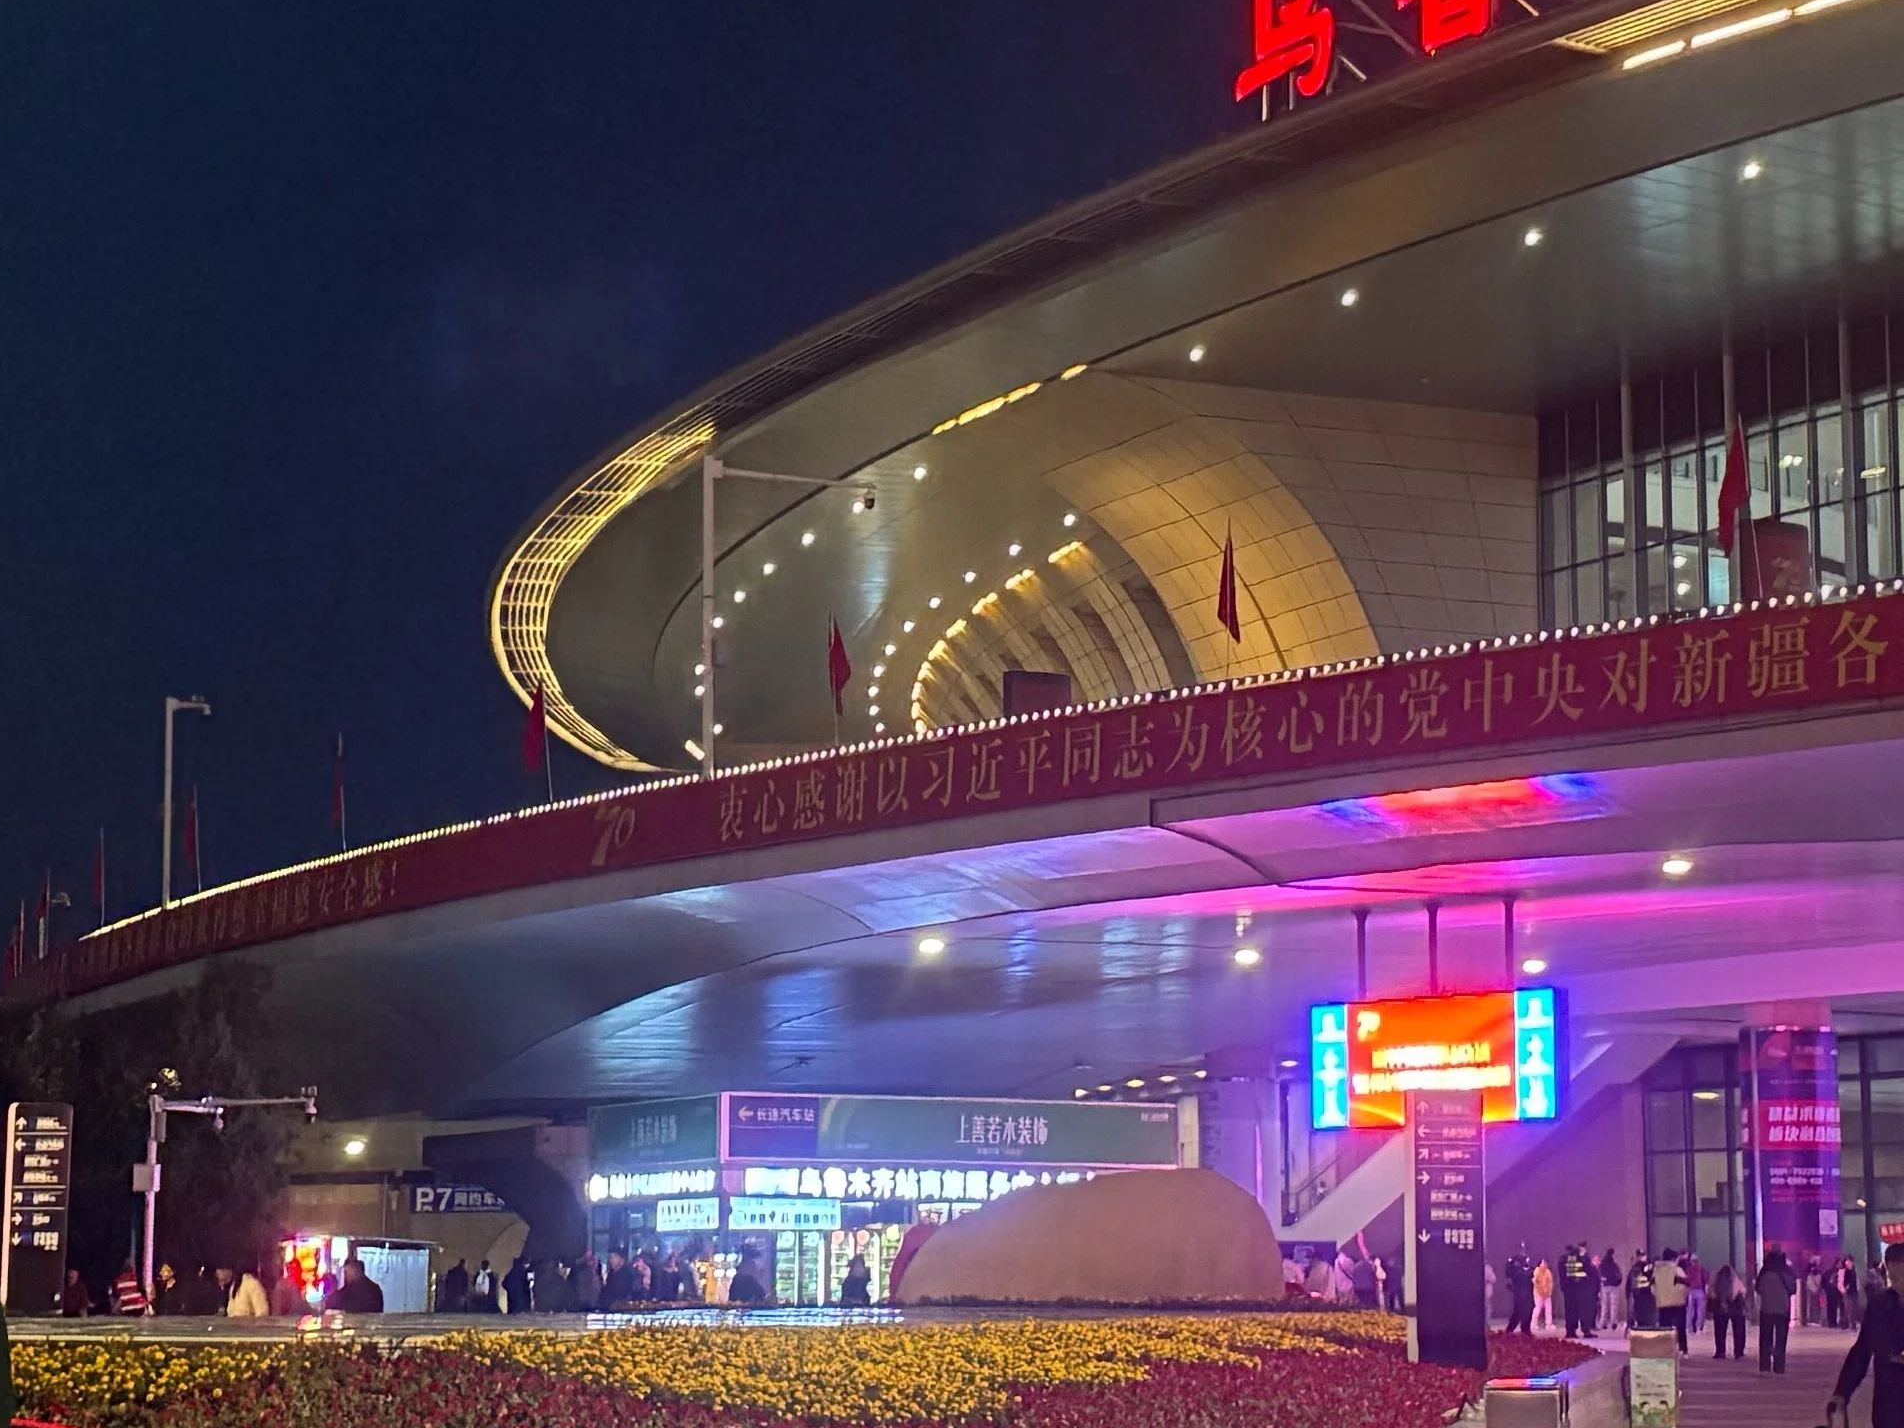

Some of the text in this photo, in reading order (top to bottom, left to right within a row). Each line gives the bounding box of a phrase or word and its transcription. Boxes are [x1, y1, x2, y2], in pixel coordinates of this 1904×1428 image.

[956, 1114, 1048, 1145] 上善若水装饰
